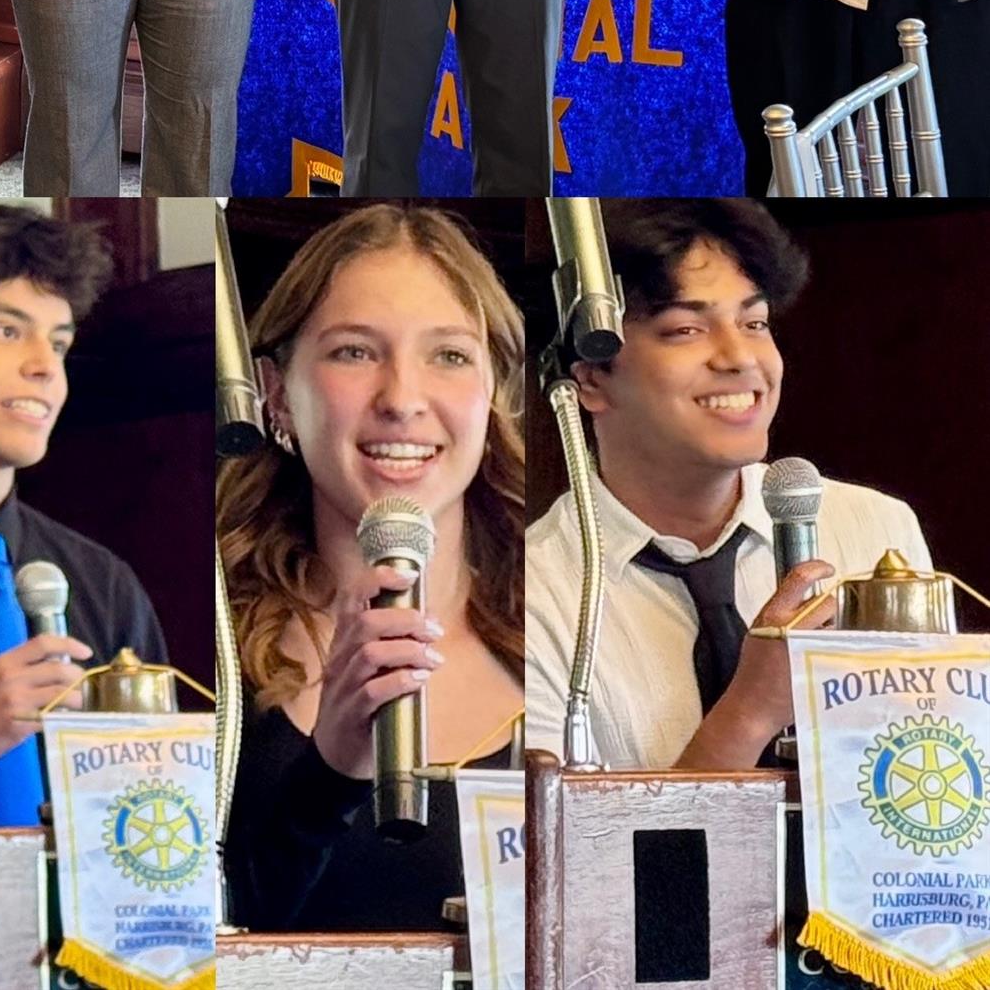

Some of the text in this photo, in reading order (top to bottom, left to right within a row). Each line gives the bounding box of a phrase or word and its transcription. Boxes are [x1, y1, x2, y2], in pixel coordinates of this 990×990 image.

[822, 667, 990, 710] ROTARY CLU
[917, 698, 936, 710] OF
[902, 727, 958, 745] ROTARY
[72, 741, 212, 778] ROTARY CLU
[872, 872, 953, 888] COLONIAL
[872, 911, 990, 930] CHARTERED 195
